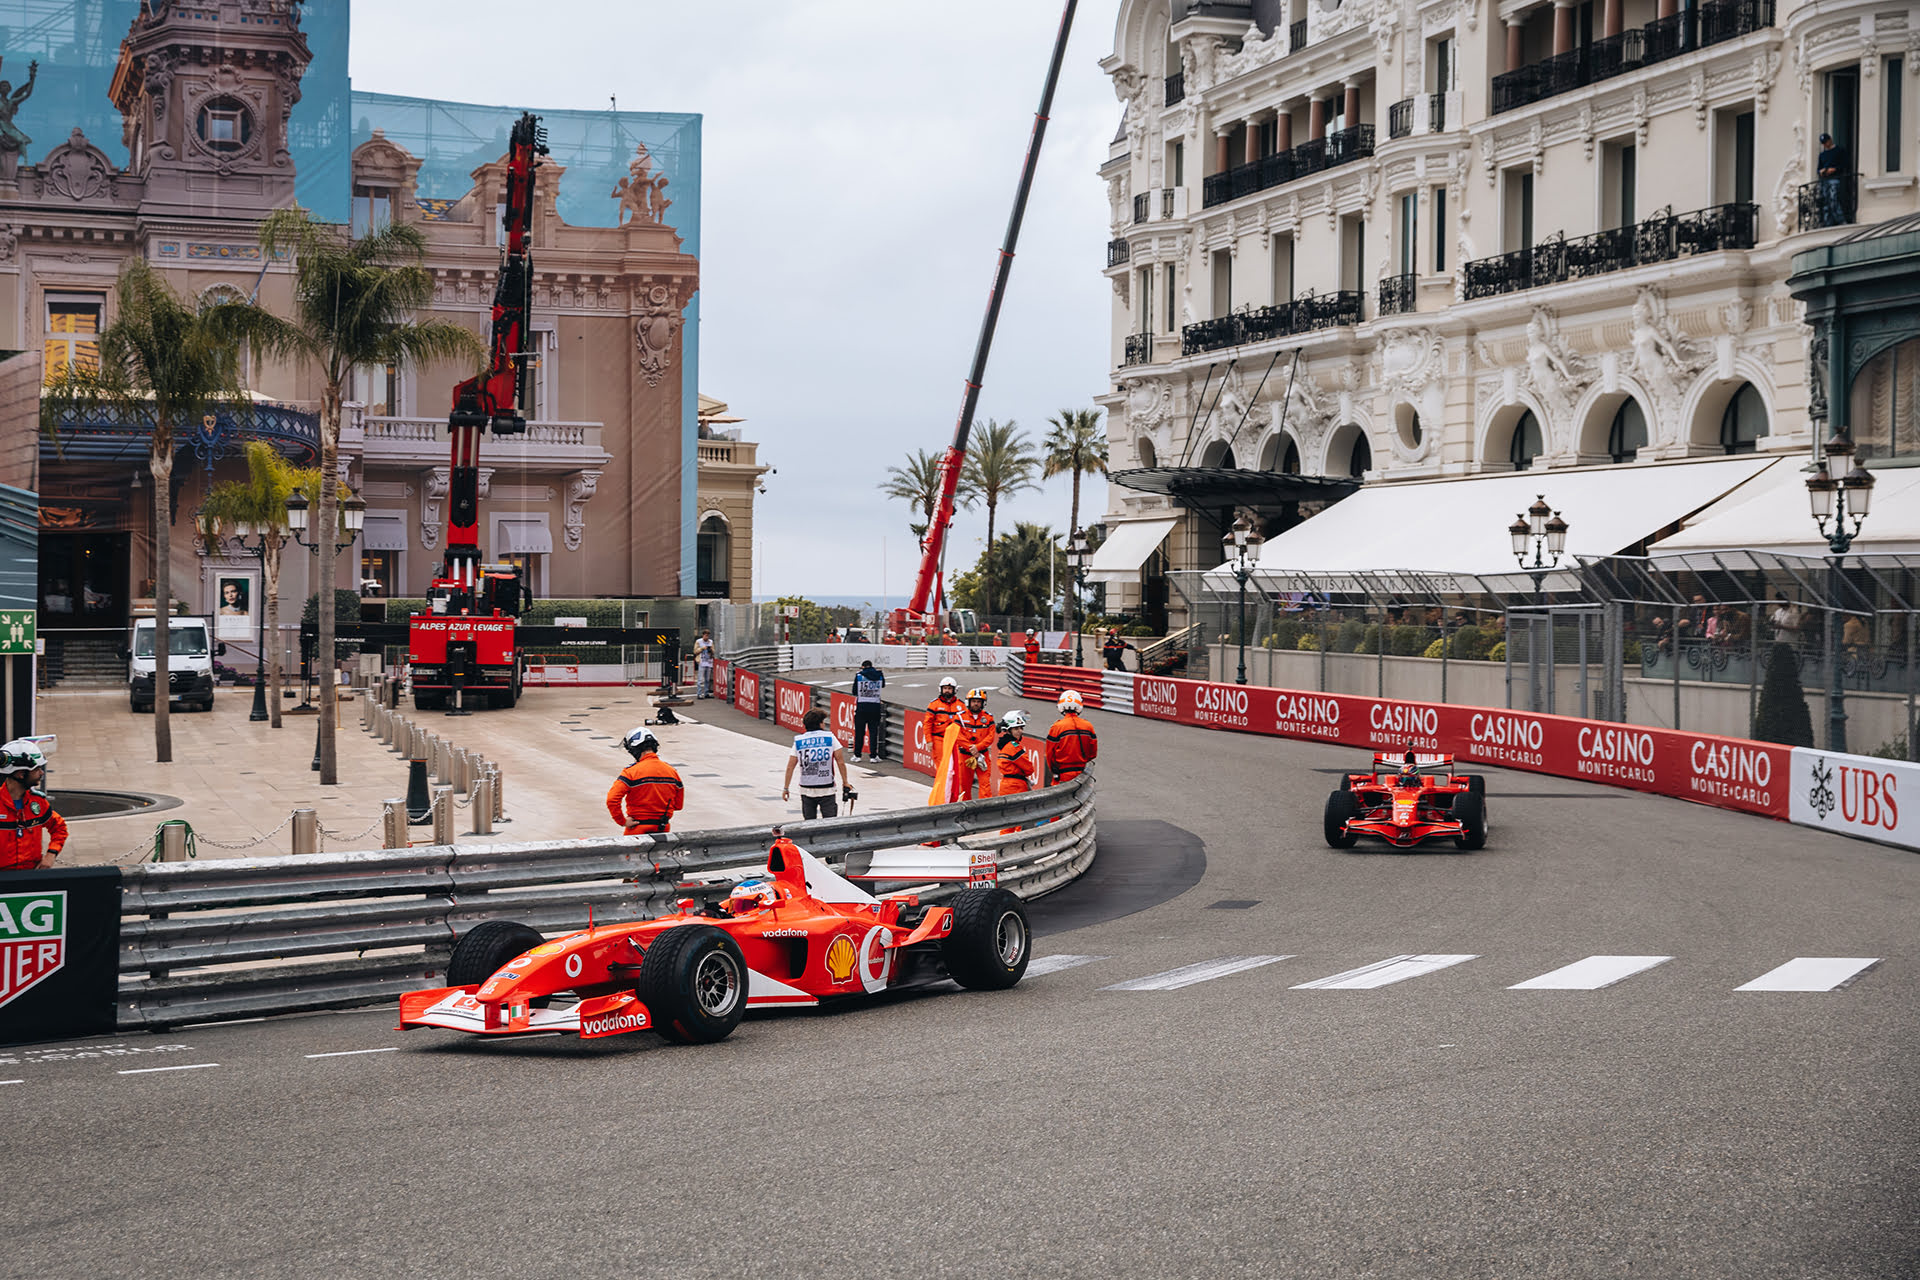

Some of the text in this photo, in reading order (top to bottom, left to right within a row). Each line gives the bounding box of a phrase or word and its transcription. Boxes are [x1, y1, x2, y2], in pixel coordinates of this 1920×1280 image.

[448, 623, 471, 631] AZUR
[947, 649, 963, 664] UBS
[980, 649, 997, 664] UBS
[780, 687, 805, 715] CASINO
[1140, 680, 1177, 704] CASINO
[1195, 686, 1248, 714] CASINO
[1276, 695, 1340, 724] CASINO
[1370, 703, 1438, 735] CASINO
[801, 737, 825, 745] PHOTO
[1470, 713, 1543, 750] CASINO
[810, 748, 830, 761] 286
[1577, 727, 1654, 766] CASINO
[1691, 741, 1771, 787] CASINO
[1839, 766, 1898, 831] UBS
[977, 853, 996, 863] Shell
[761, 928, 808, 938] vodafone
[582, 1011, 647, 1035] vodafone
